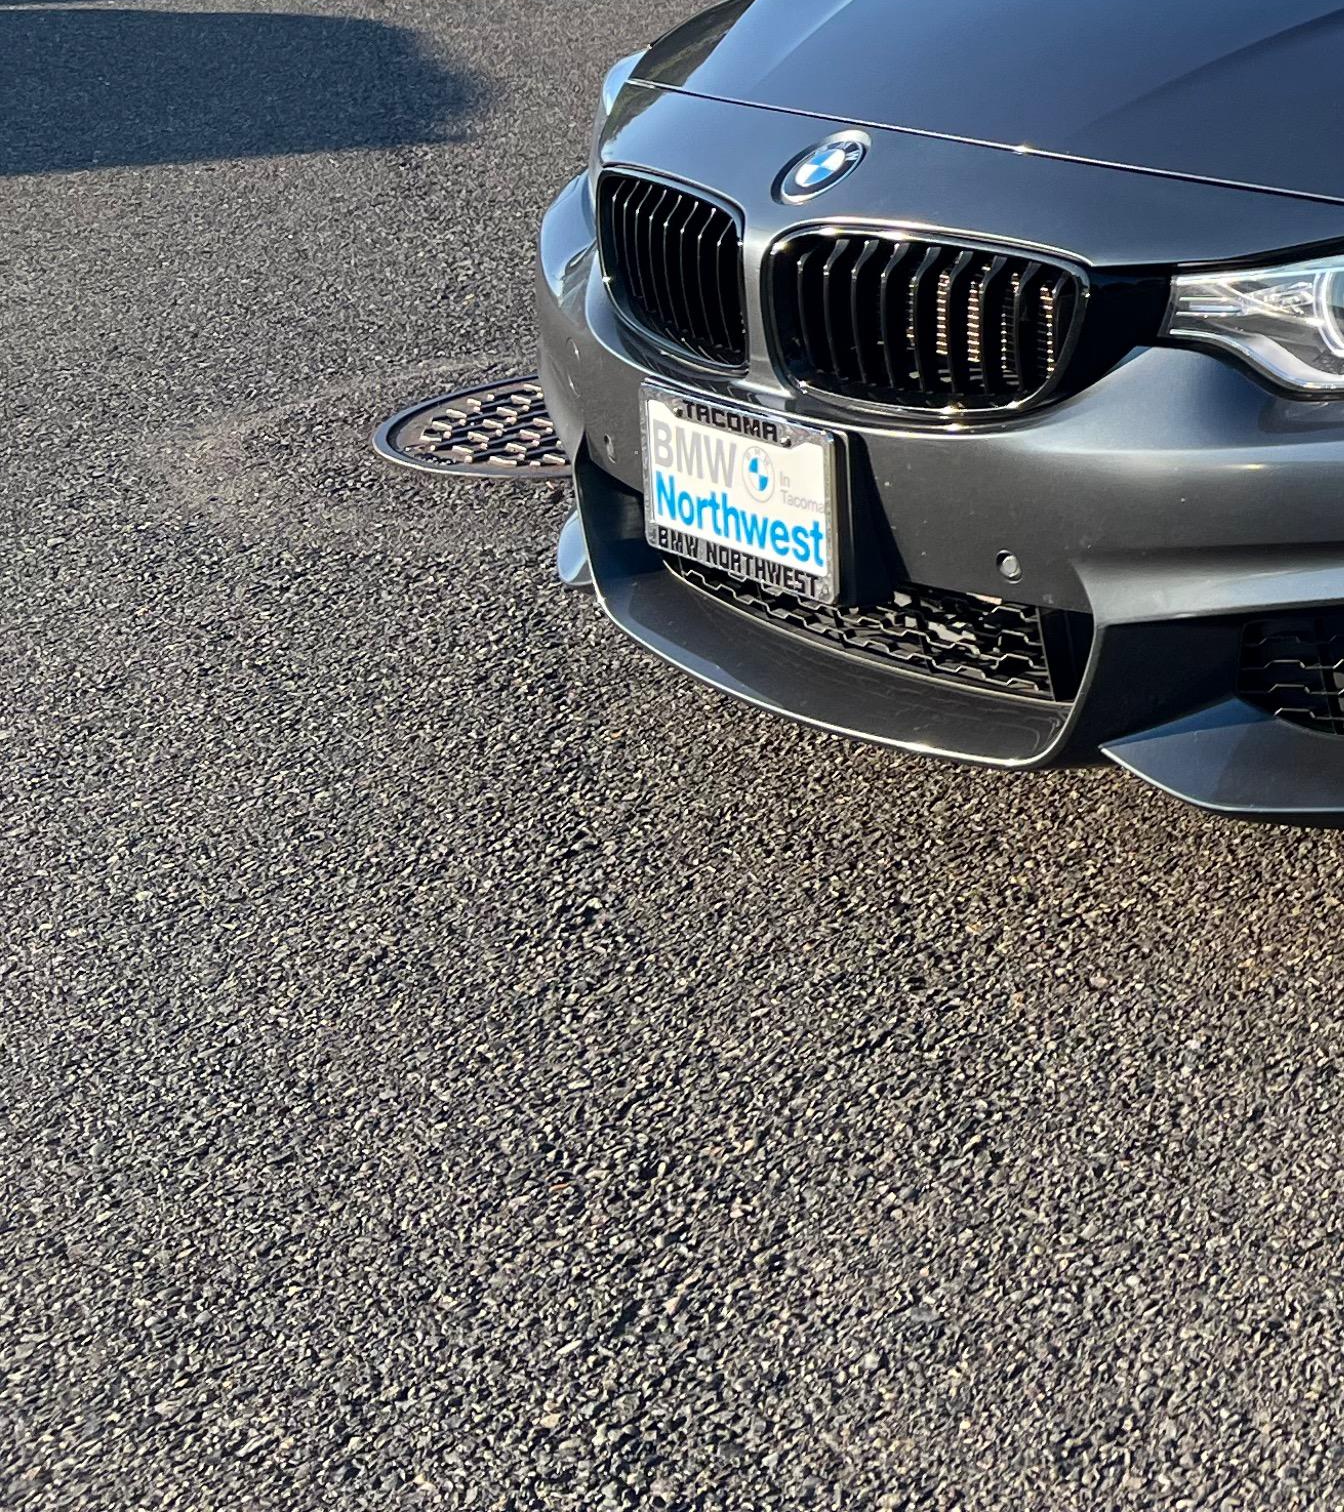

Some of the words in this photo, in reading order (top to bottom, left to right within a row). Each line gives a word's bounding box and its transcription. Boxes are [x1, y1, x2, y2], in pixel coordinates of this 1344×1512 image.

[653, 419, 737, 488] BMW
[682, 399, 778, 442] TACOMA
[655, 470, 824, 567] Northwest
[780, 489, 825, 514] Tacoma
[657, 526, 699, 558] BMW
[706, 541, 818, 598] NORTHWEST
